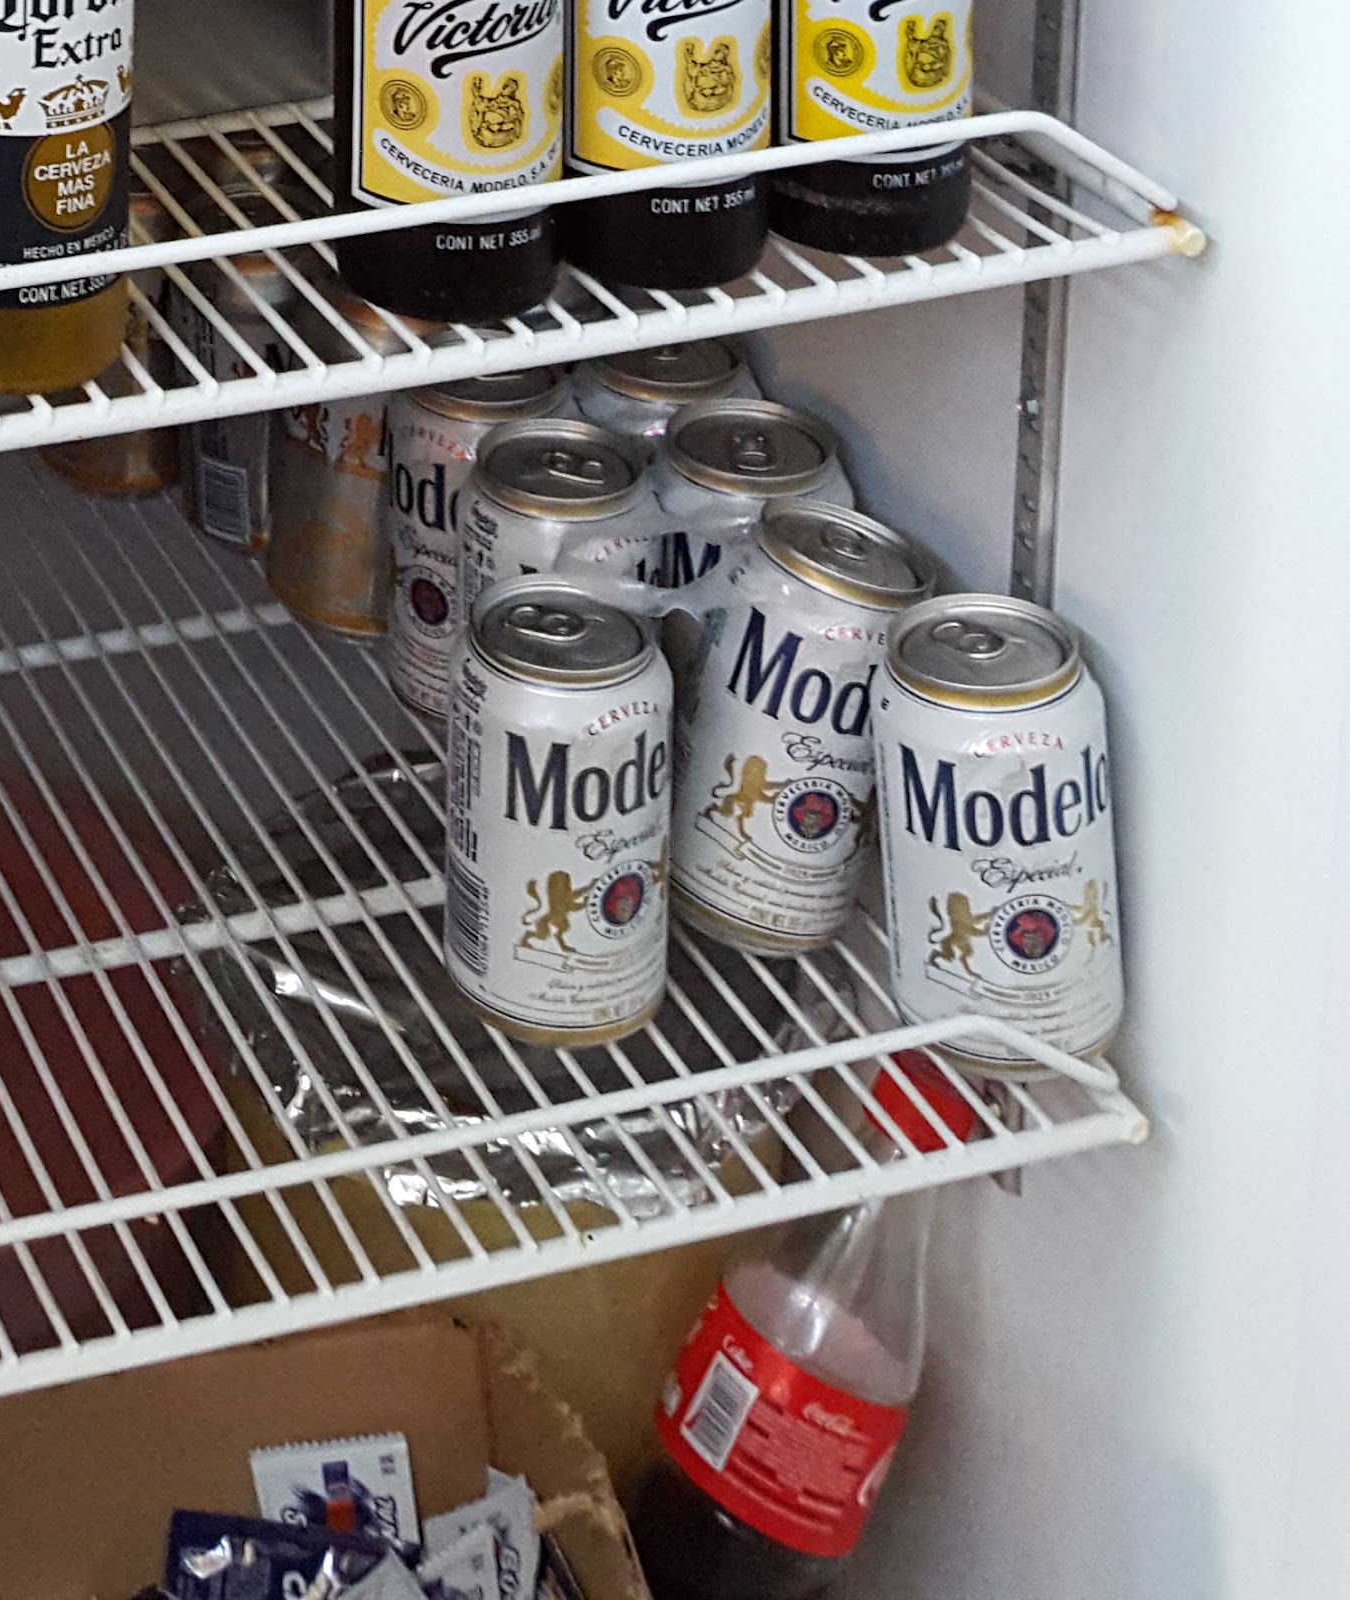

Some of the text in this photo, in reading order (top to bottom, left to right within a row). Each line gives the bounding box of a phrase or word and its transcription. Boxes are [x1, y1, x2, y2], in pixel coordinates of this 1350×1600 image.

[32, 26, 123, 70] Extra
[813, 85, 901, 130] CERVECERIA
[66, 141, 89, 159] LA
[618, 124, 724, 157] CERVECERIA
[34, 149, 113, 182] CERVEZA
[380, 137, 465, 191] CERVECERIA
[58, 176, 96, 198] MAS
[56, 194, 96, 216] FINA
[23, 244, 64, 259] HECHO
[825, 627, 885, 646] CERVE
[727, 607, 878, 736] Mod
[505, 730, 667, 832] Mode
